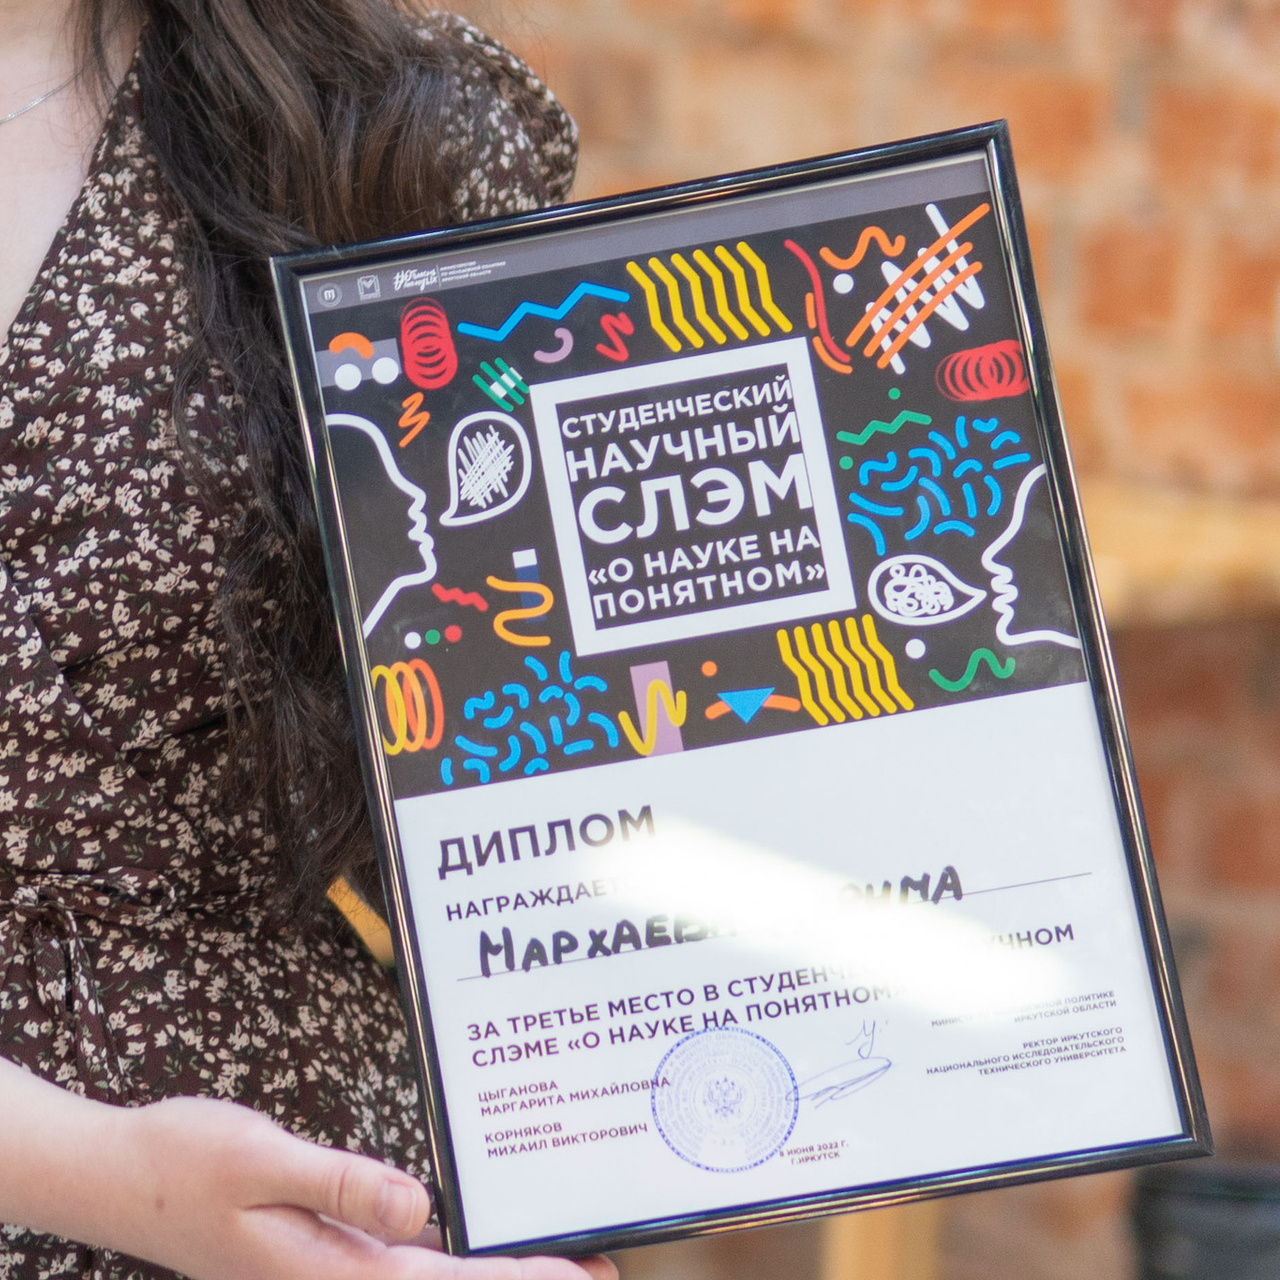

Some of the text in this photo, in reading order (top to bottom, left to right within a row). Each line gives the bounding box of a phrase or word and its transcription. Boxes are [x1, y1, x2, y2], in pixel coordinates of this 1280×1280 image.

[562, 374, 793, 438] СТУДЕНЧЕСКИЙ
[566, 403, 801, 482] НАУЧНЫЙ
[578, 453, 814, 544] СЛЭМ
[588, 525, 821, 585] «О НАУКЕ НА
[593, 560, 826, 619] ПОНЯТНОМ»
[438, 805, 656, 880] ДИПЛОМ
[446, 877, 617, 921] НАГРАЖДАЕ
[467, 1021, 500, 1041] ЗА
[507, 1004, 600, 1034] ТРЕТЬЕ
[608, 988, 695, 1018] МЕСТО
[703, 984, 720, 1002] В
[1065, 990, 1115, 1005] ПОЛИТИКЕ
[1072, 1000, 1117, 1014] ОБЛАСТИ
[472, 1038, 559, 1067] СЛЭМЕ
[568, 1031, 600, 1051] «О
[609, 1015, 695, 1046] НАУКЕ
[702, 1008, 738, 1031] НА
[926, 1036, 1125, 1075] НАЦИОНАЛЬНОГО ИССЛЕДОВАТЕЛЬСКОГО
[1023, 1026, 1123, 1049] РЕКТОР ИРКУТСКОГО
[978, 1046, 1127, 1076] ТЕХНИЧЕСКОГО УНИВЕРСИТЕТА
[478, 1080, 559, 1102] ЦЫГАНОВА
[480, 1077, 670, 1117] МАРГАРИТА МИХАЙЛОВНА
[485, 1122, 563, 1144] КОРНЯКОВ
[487, 1123, 648, 1158] МИХАИЛ ВИКТОРОВИЧ
[787, 1145, 815, 1156] ИЮНЯ
[817, 1141, 839, 1151] 2022
